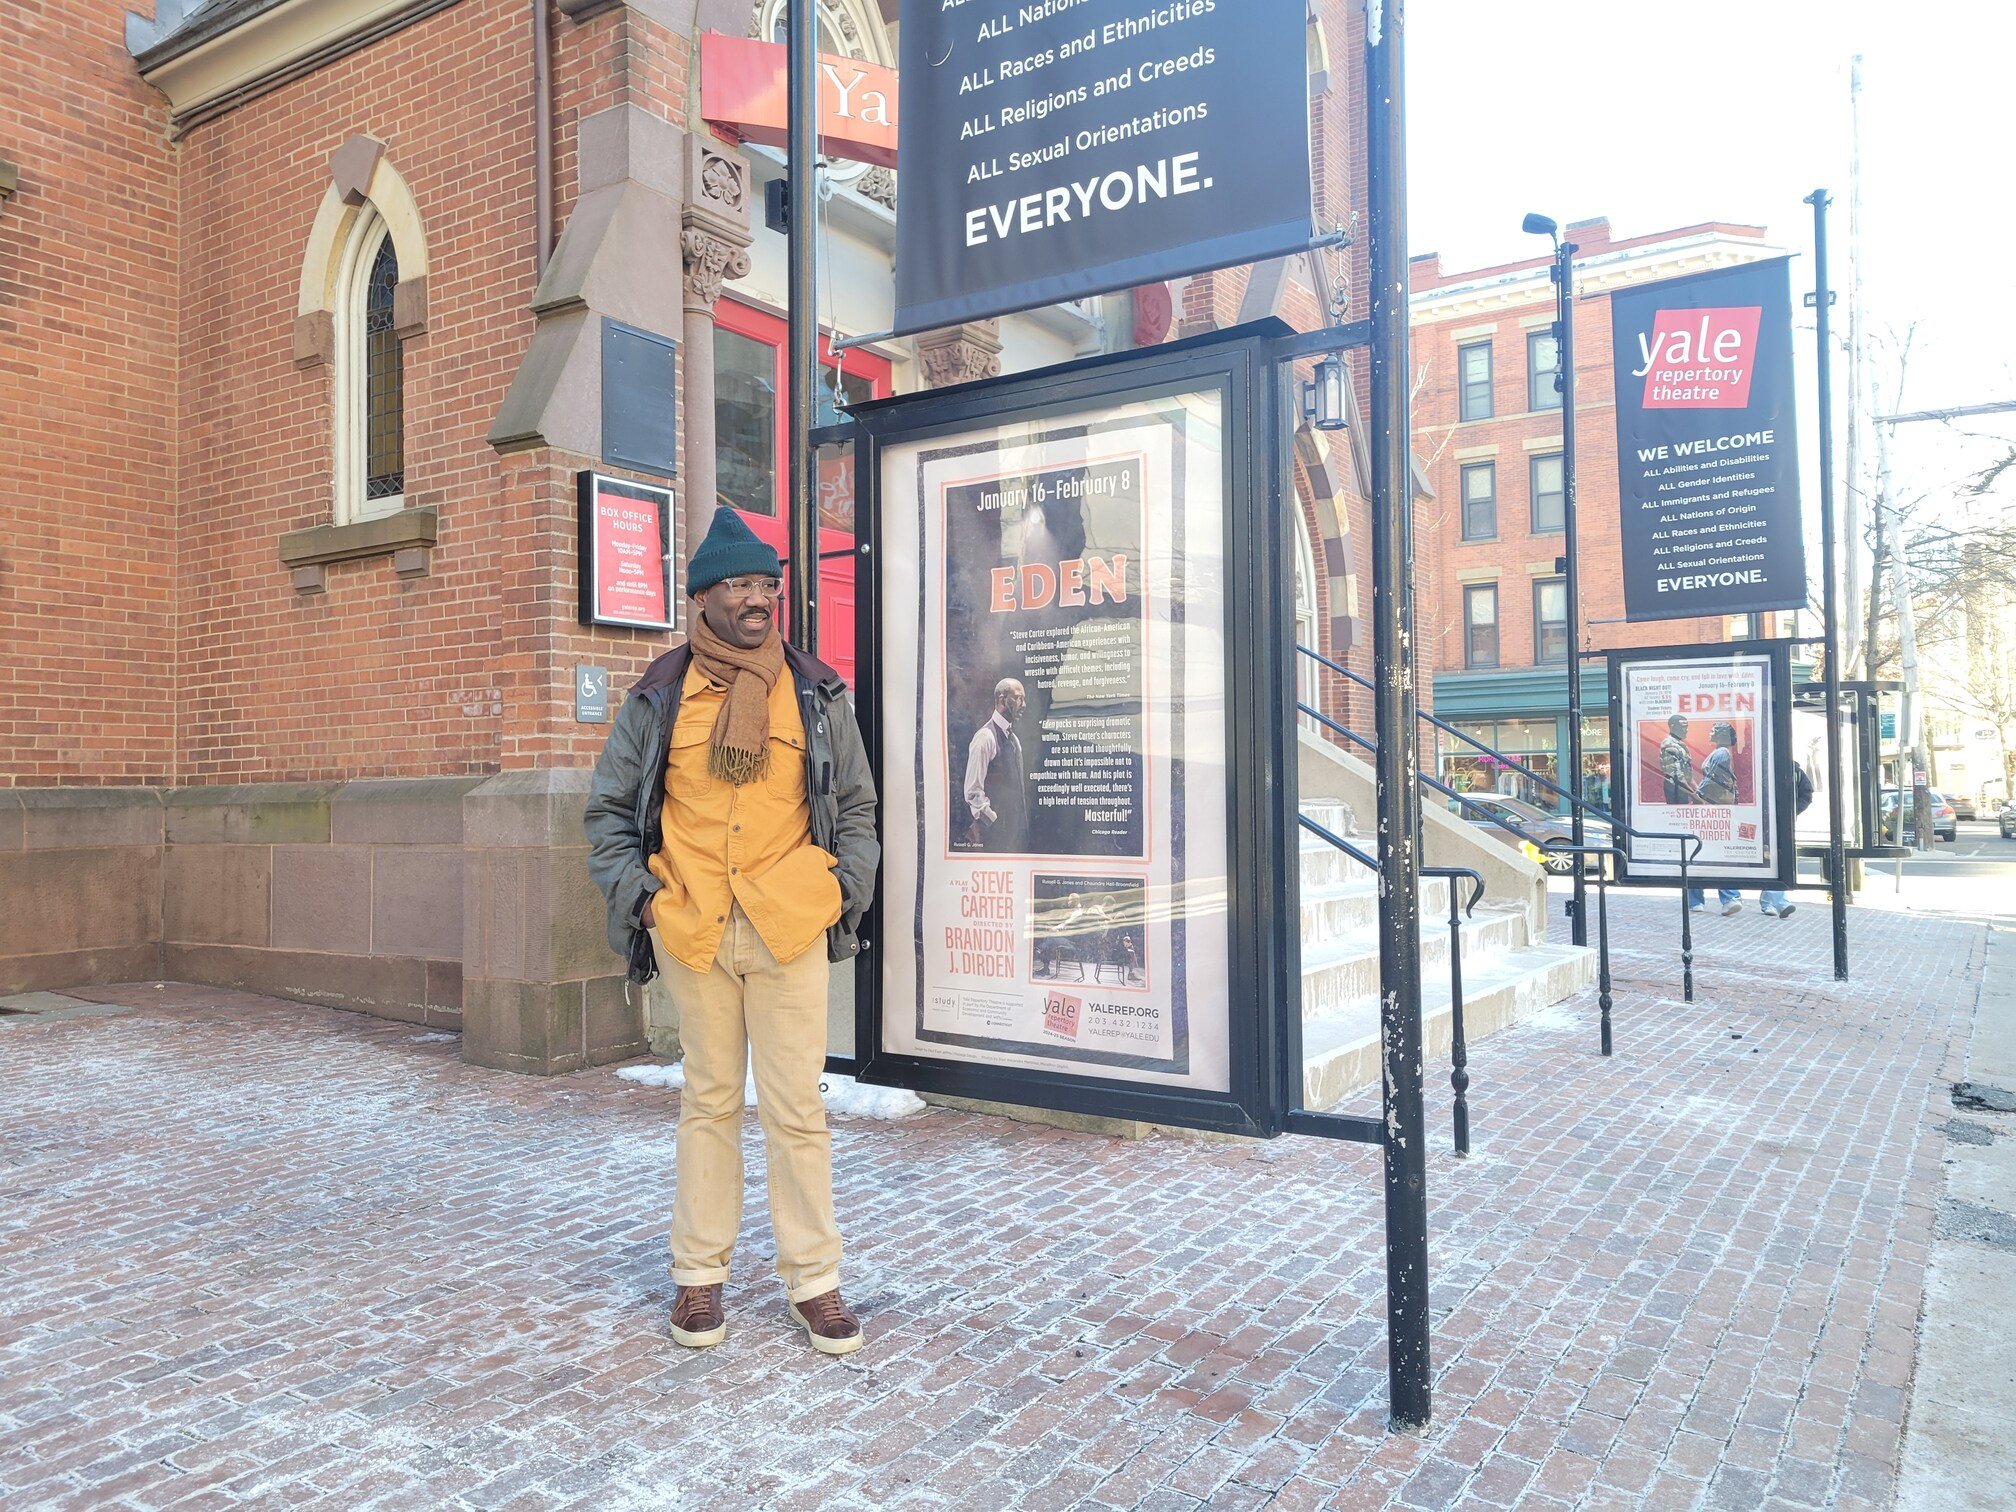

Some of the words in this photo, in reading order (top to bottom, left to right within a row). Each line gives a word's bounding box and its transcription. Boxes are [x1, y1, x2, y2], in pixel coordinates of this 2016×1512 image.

[977, 15, 1013, 42] ALL
[959, 69, 994, 95] ALL
[1000, 49, 1054, 81] Races
[1060, 29, 1096, 59] and
[1103, 0, 1217, 45] Ethnicities
[960, 114, 995, 141] ALL
[1001, 86, 1087, 127] Religions
[1093, 68, 1131, 97] and
[1138, 46, 1215, 82] Creeds
[967, 159, 1003, 184] ALL
[1009, 136, 1070, 171] Sexual
[1076, 103, 1207, 150] Orientations
[966, 152, 1213, 247] EVERYONE.
[1631, 315, 1742, 377] yale
[1655, 366, 1742, 385] repertory
[1652, 386, 1719, 401] theatre
[1637, 446, 1669, 462] WE
[1674, 430, 1774, 456] WELCOME
[1643, 469, 1661, 477] ALL
[1663, 464, 1699, 475] Abilities
[1701, 461, 1717, 469] and
[1720, 454, 1770, 467] Disabilities
[977, 485, 1028, 512] January
[1121, 470, 1130, 490] 8
[1658, 483, 1676, 491] ALL
[1678, 478, 1710, 488] Gender
[1713, 472, 1755, 484] Identities
[1642, 501, 1659, 509] ALL
[1661, 495, 1710, 507] Immigrants
[1713, 491, 1729, 500] and
[1732, 486, 1775, 498] Refugees
[600, 507, 618, 517] BOX
[622, 510, 652, 523] OFFICE
[1660, 514, 1678, 522] ALL
[1680, 510, 1713, 520] Nations
[1716, 507, 1725, 515] of
[1728, 505, 1756, 514] Origin
[613, 520, 643, 532] HOURS
[1652, 531, 1670, 539] ALL
[1672, 528, 1698, 537] Races
[1700, 525, 1716, 533] and
[1719, 520, 1767, 531] Ethnicities
[1653, 547, 1671, 555] ALL
[1673, 542, 1713, 553] Religions
[1716, 540, 1733, 548] and
[1735, 536, 1767, 545] Creeds
[1657, 563, 1675, 571] ALL
[1677, 559, 1706, 568] Sexual
[1708, 554, 1765, 565] Orientations
[989, 554, 1128, 613] EDEN
[1657, 569, 1768, 592] EVERYONE.
[1677, 693, 1755, 713] EDEN
[1085, 809, 1132, 822] Masterful!"
[1676, 808, 1699, 818] STEVE
[1701, 809, 1731, 819] CARTER
[1690, 820, 1731, 830] BRANDON
[1700, 831, 1731, 840] DIRDEN
[971, 871, 1013, 894] STEVE
[961, 895, 1013, 919] CARTER
[945, 926, 1014, 953] BRANDON
[950, 951, 958, 973] J.
[962, 952, 1014, 978] DIRDEN
[1041, 997, 1075, 1018] yale
[1088, 1003, 1159, 1018] YALEREP.ORG
[1047, 1020, 1068, 1032] theatre
[1048, 1014, 1075, 1027] repertory
